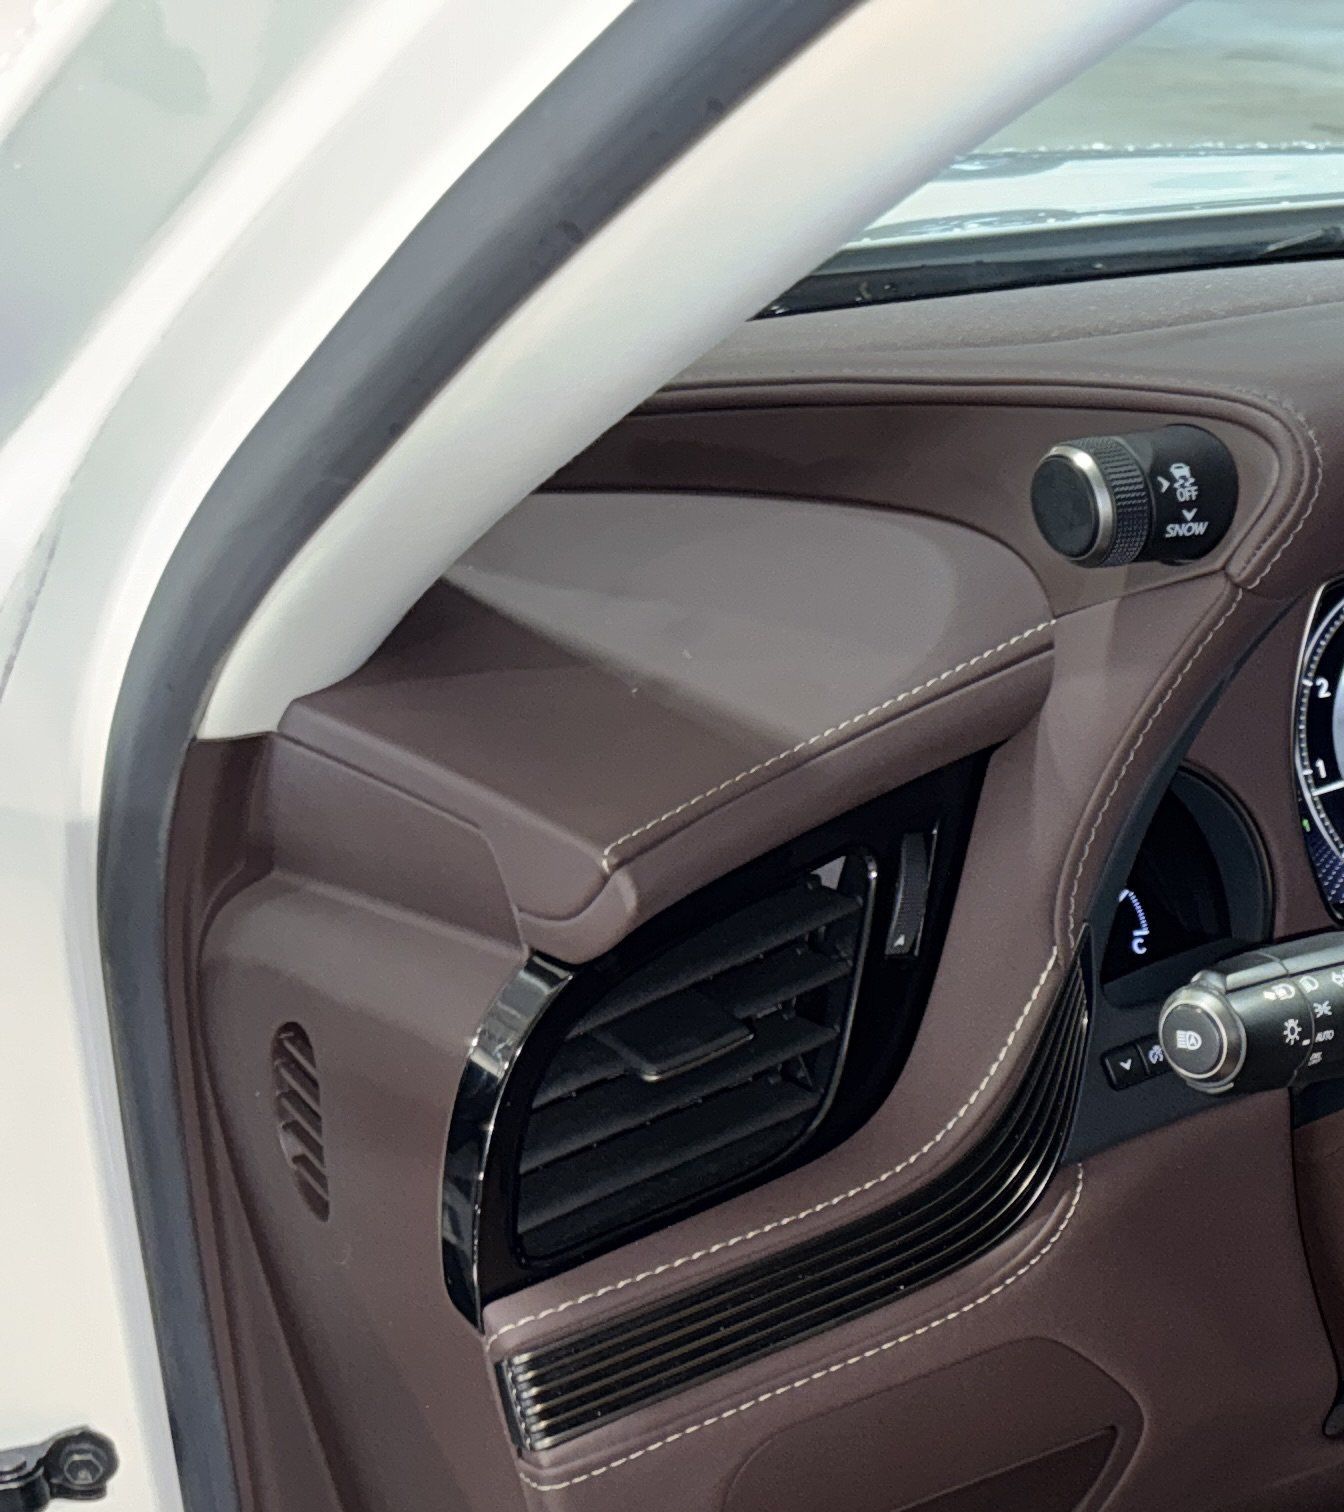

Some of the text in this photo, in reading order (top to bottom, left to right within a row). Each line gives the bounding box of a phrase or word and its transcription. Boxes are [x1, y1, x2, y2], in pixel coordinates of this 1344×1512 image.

[1176, 486, 1198, 502] OFF
[1166, 521, 1208, 538] SNOW
[1315, 679, 1331, 698] 2
